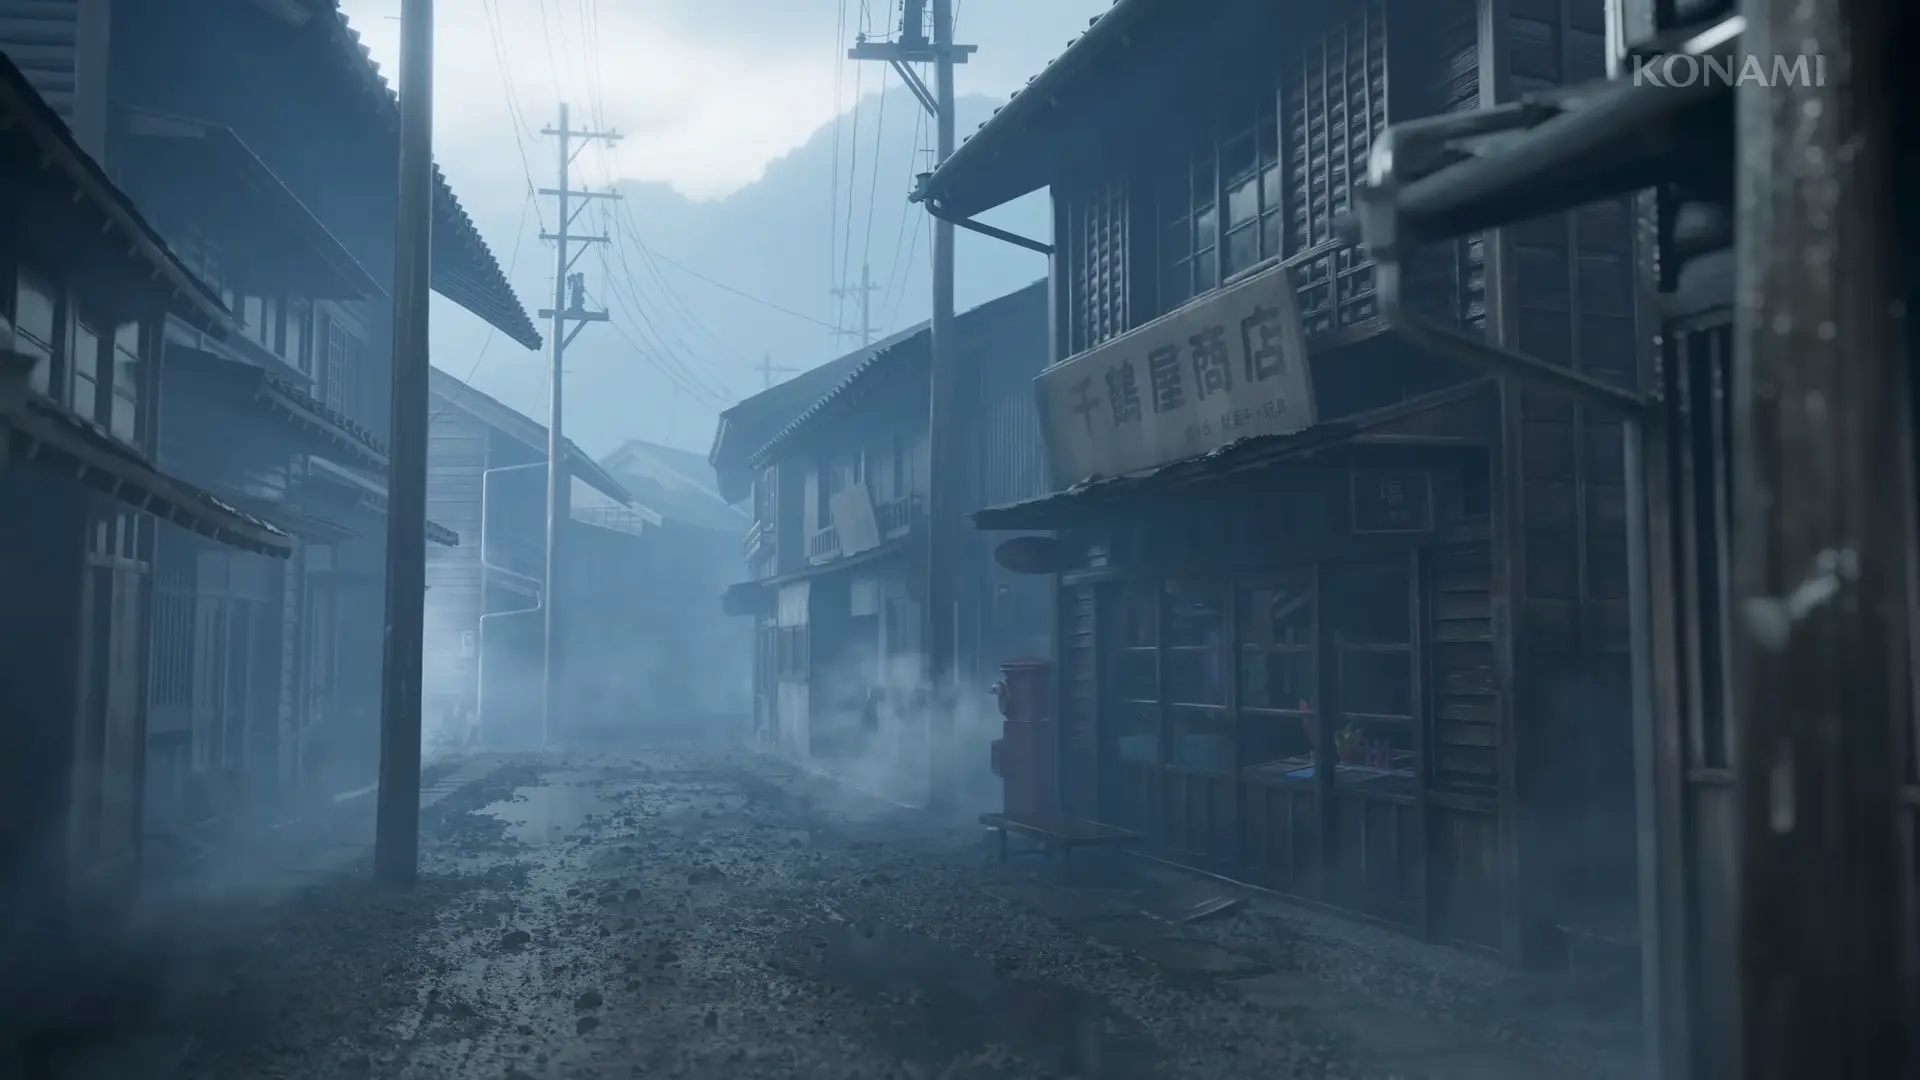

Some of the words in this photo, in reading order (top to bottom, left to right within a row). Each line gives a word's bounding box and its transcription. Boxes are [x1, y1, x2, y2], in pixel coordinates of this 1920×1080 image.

[1069, 305, 1287, 438] 千鶴屋商店
